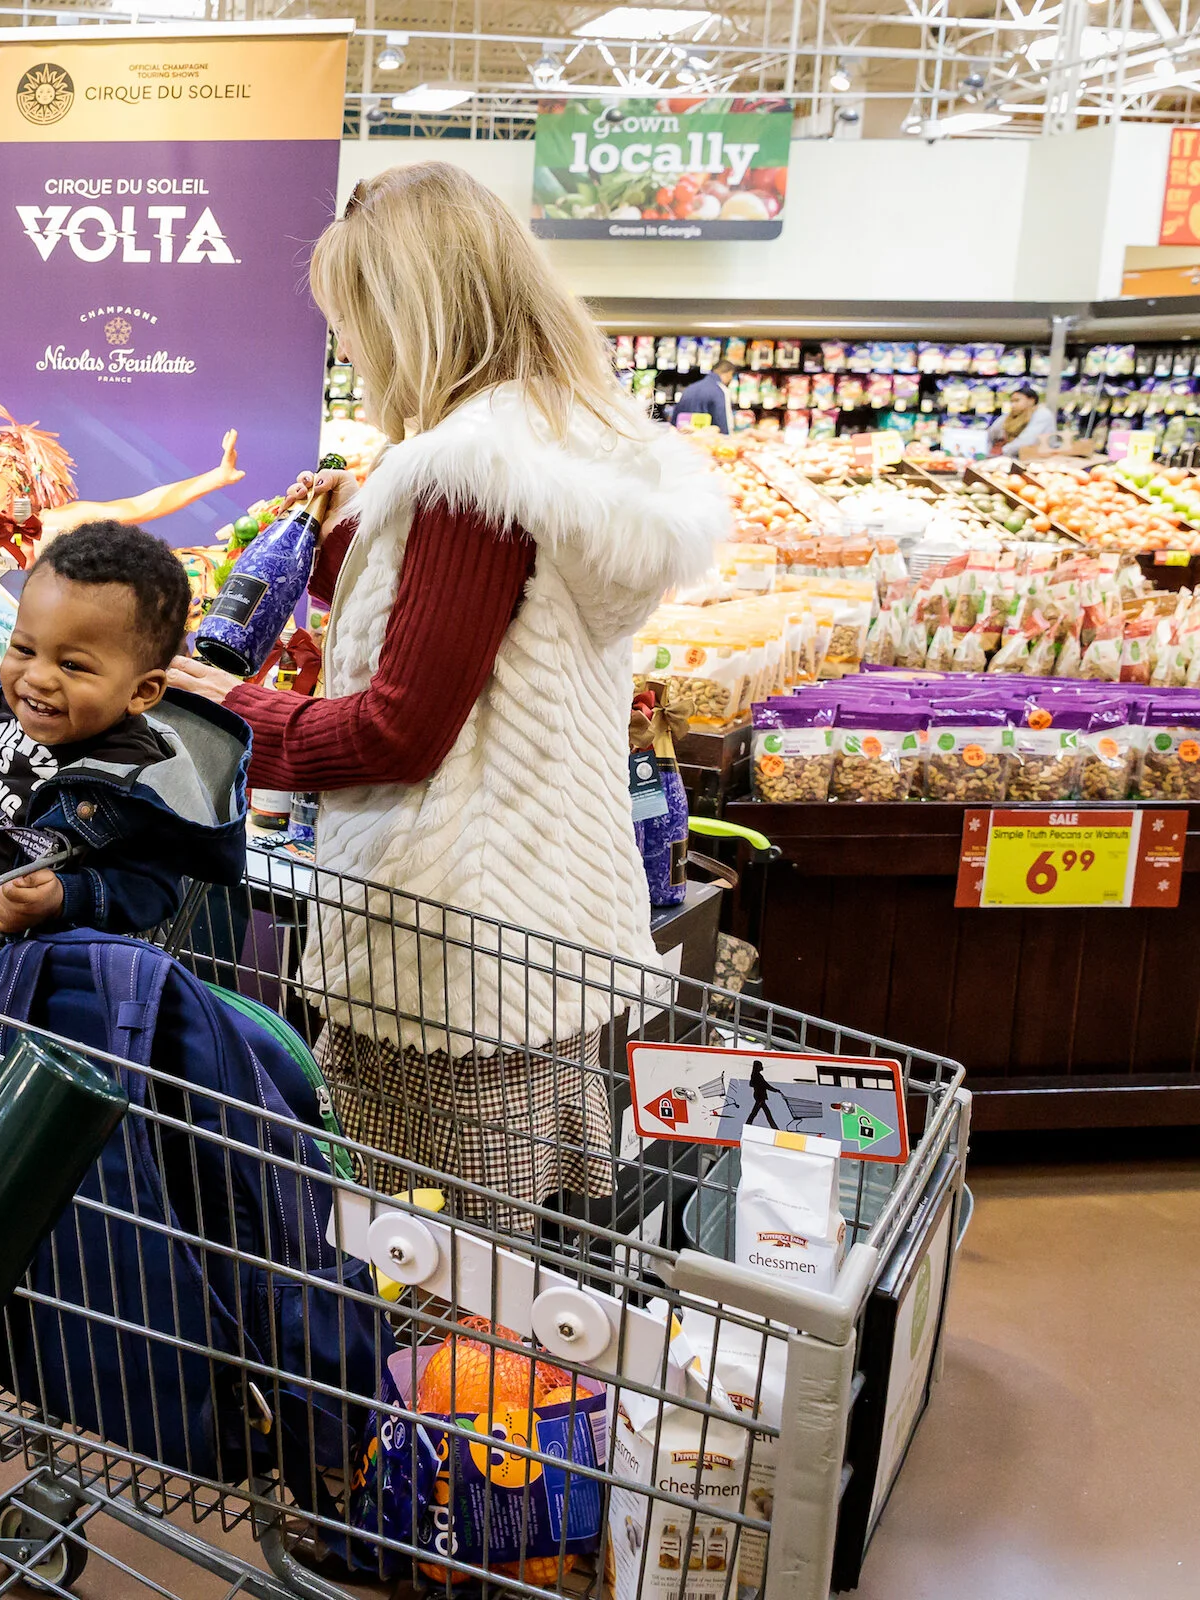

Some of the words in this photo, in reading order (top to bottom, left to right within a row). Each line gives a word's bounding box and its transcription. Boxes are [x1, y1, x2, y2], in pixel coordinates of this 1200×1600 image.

[85, 85, 151, 104] CIRQUE
[158, 85, 183, 99] DU
[188, 84, 250, 99] SOLEIL
[569, 132, 760, 186] locally
[45, 178, 112, 199] CIRQUE
[116, 178, 142, 194] DU
[146, 178, 209, 194] SOLEIL
[15, 205, 236, 264] VOLTA
[609, 224, 643, 236] Grown
[644, 224, 657, 236] in
[658, 224, 702, 238] Georgia
[80, 305, 158, 325] CHAMPAGNE
[36, 344, 105, 372] Nicolas
[108, 348, 197, 374] Feuillatte
[97, 376, 132, 384] FRANCE
[1048, 813, 1079, 826] SALE
[993, 829, 1024, 842] Simple
[1026, 829, 1047, 840] Truth
[1049, 829, 1082, 840] Pecans
[1083, 831, 1094, 840] or
[1095, 829, 1129, 840] Walnuts
[761, 1232, 790, 1242] PEPPERIDGE
[790, 1235, 806, 1246] FARM
[748, 1252, 817, 1274] chessmen
[608, 1426, 640, 1475] cssmen
[675, 1452, 711, 1462] PEPPERGE
[712, 1455, 730, 1466] FARM
[658, 1477, 740, 1497] chessmen
